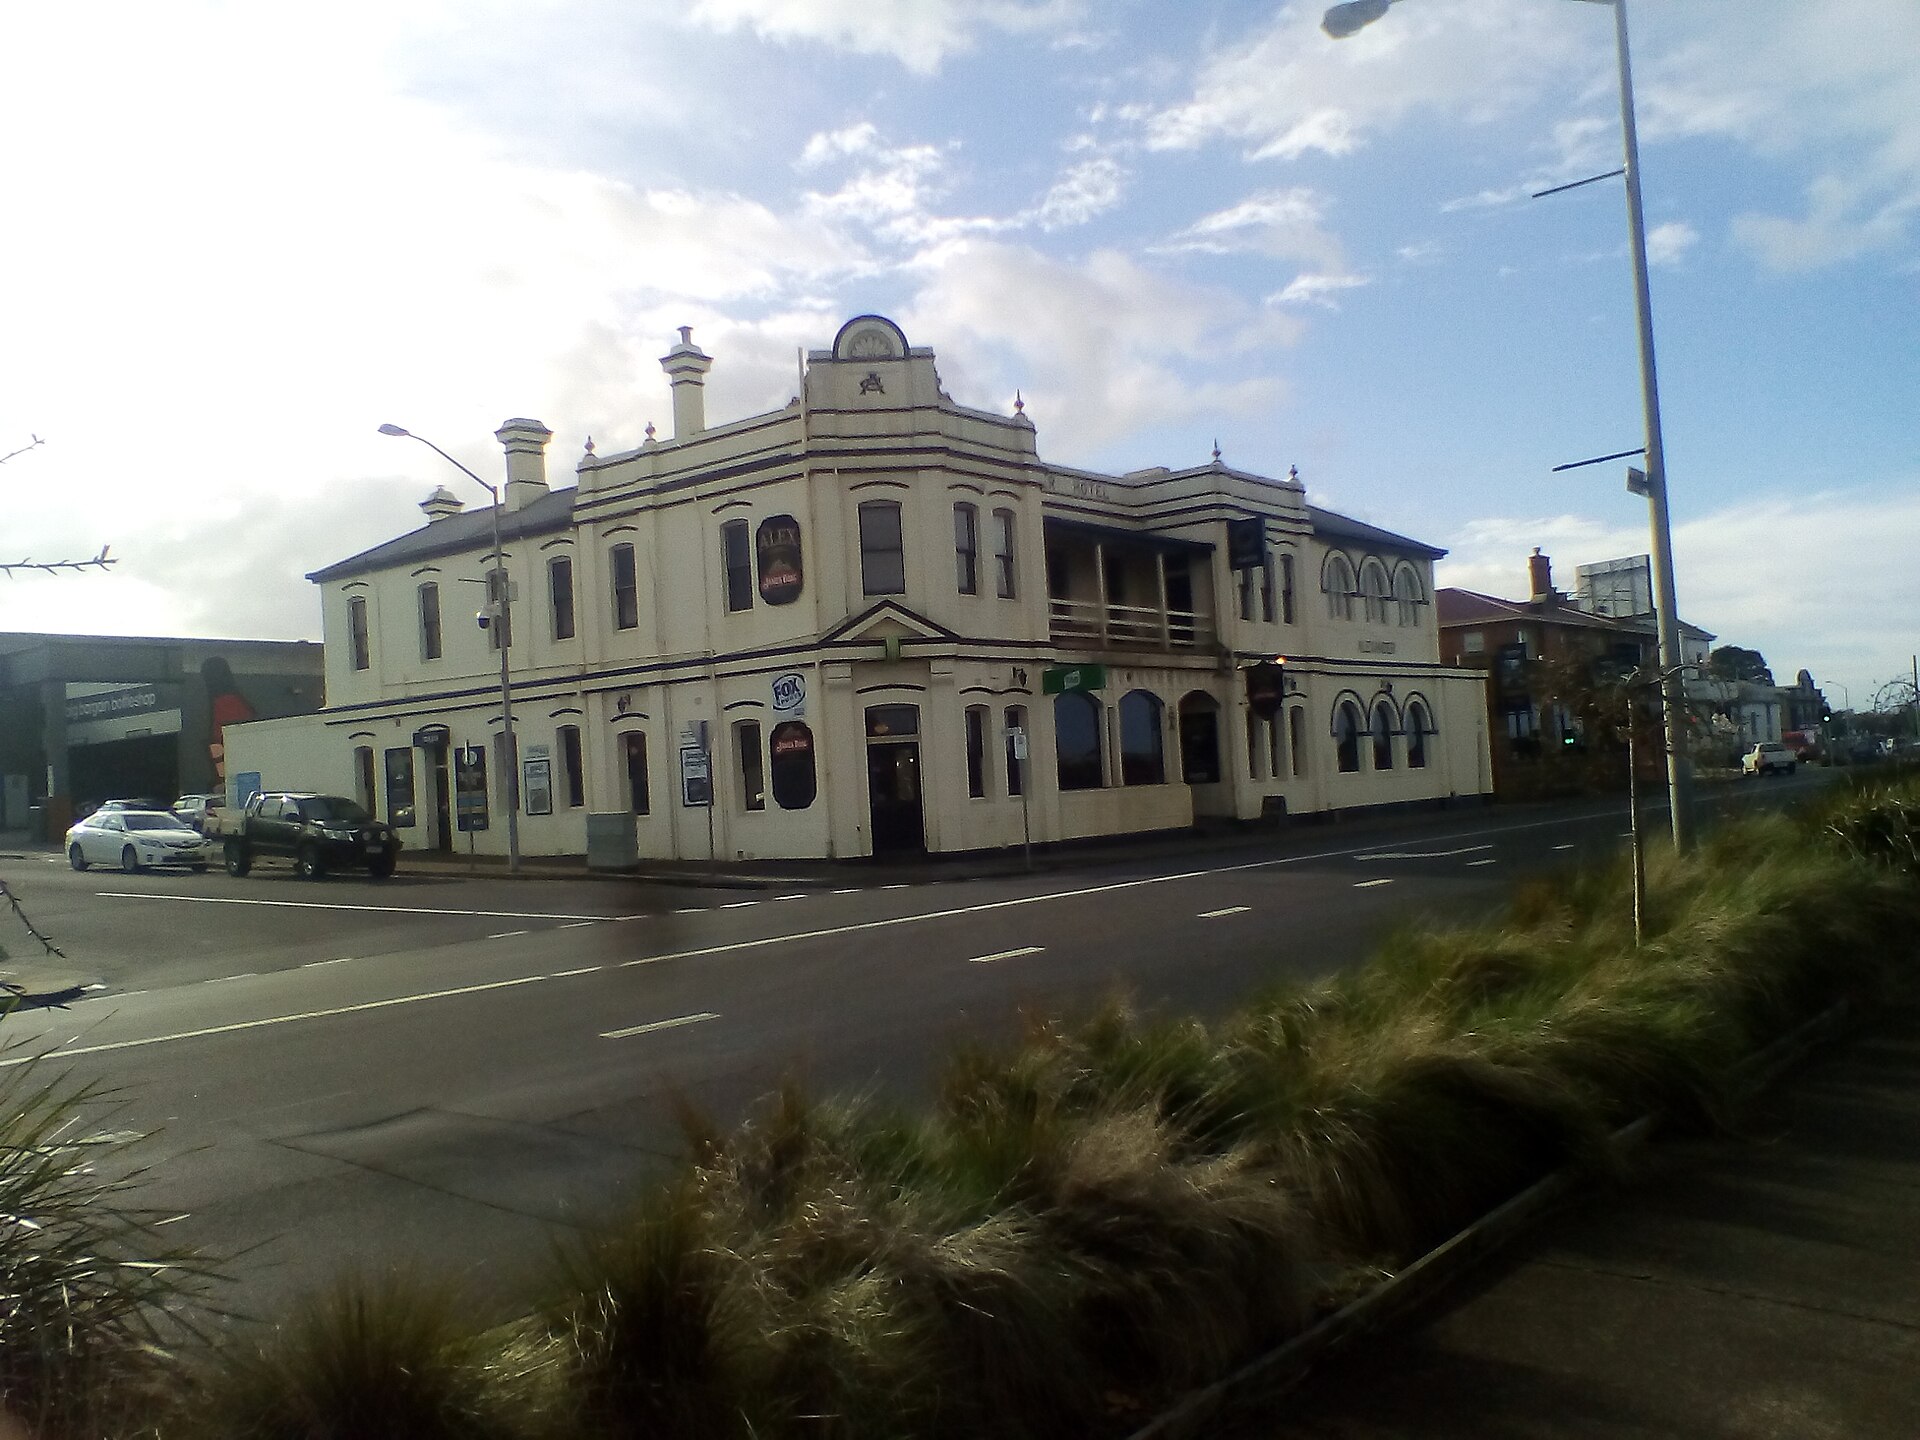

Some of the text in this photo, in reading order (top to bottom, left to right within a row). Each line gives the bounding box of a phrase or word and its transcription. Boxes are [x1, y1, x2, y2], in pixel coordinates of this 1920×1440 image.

[1071, 479, 1109, 500] HOTEL
[761, 529, 798, 547] ALEX
[774, 678, 800, 706] FOX
[80, 699, 111, 717] bargain
[112, 693, 156, 711] bottleshop
